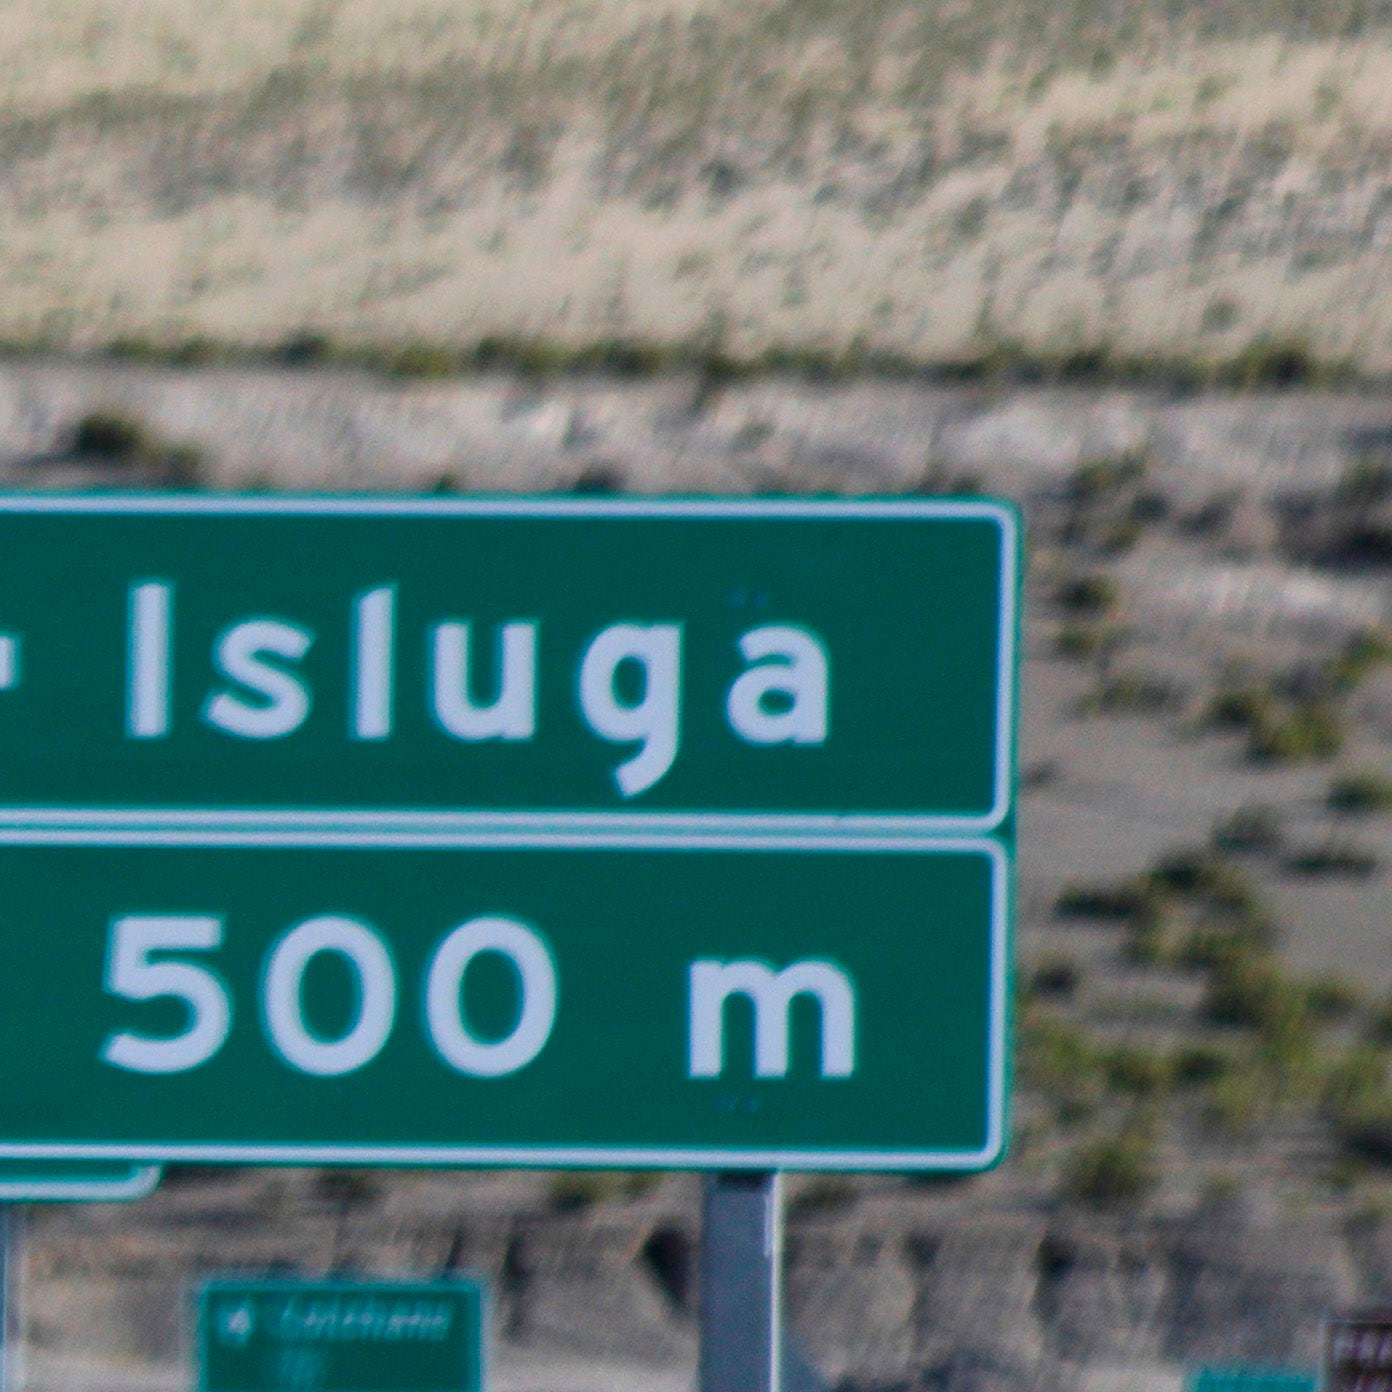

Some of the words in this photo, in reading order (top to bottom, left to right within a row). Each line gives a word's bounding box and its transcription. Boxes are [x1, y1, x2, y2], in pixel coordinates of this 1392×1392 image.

[128, 582, 830, 797] Isluga
[102, 914, 558, 1078] 500
[687, 957, 857, 1078] m
